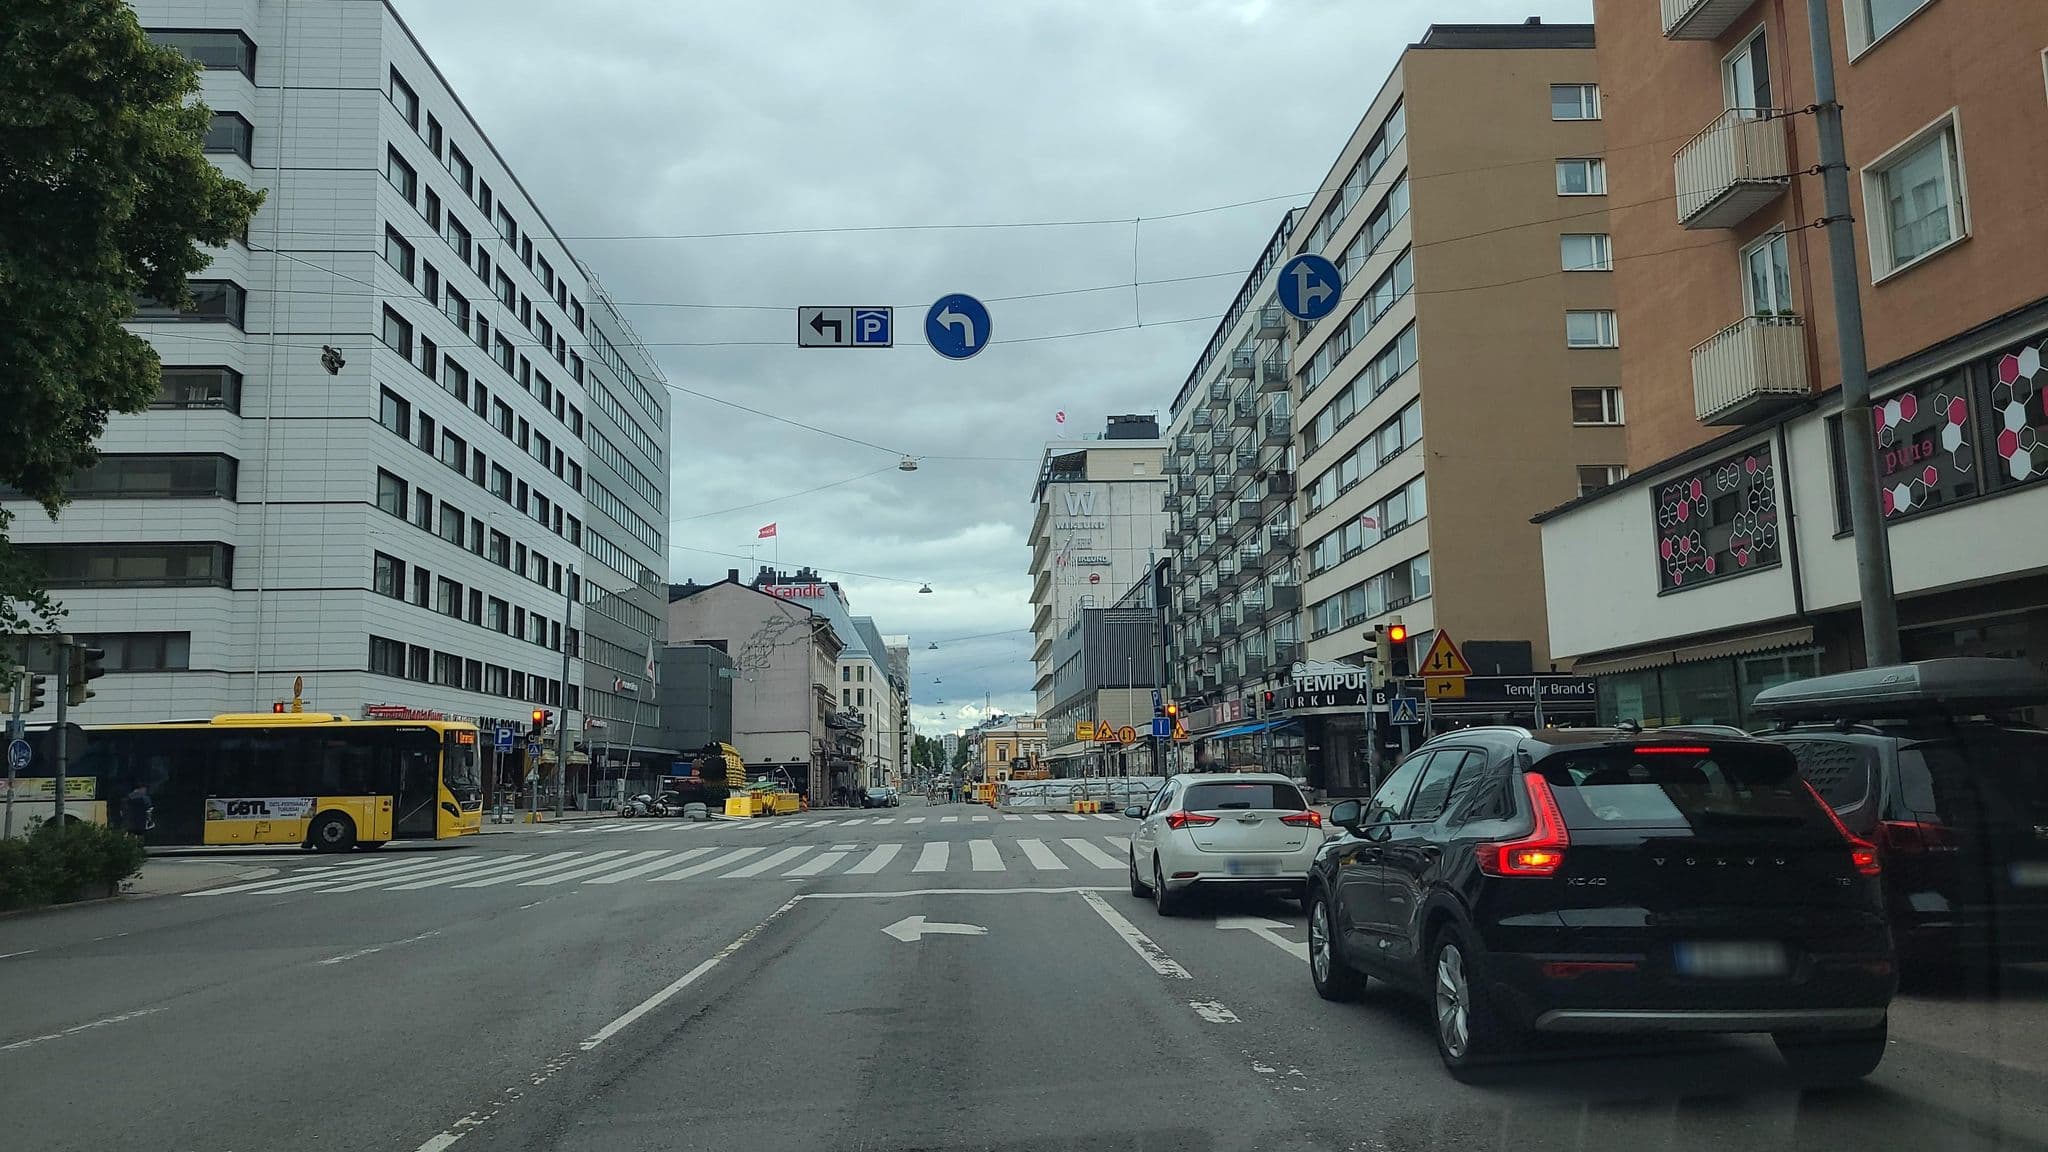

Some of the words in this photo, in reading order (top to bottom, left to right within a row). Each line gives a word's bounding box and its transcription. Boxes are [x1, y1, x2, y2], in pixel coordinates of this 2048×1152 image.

[864, 319, 881, 341] P
[1064, 490, 1096, 516] W
[1056, 521, 1105, 530] WIKLUND
[764, 582, 825, 598] Scandic
[1551, 682, 1585, 695] Brand
[1284, 695, 1336, 709] TURKU
[1356, 692, 1386, 705] AB
[498, 729, 511, 744] P
[1654, 857, 1785, 866] VOLVO
